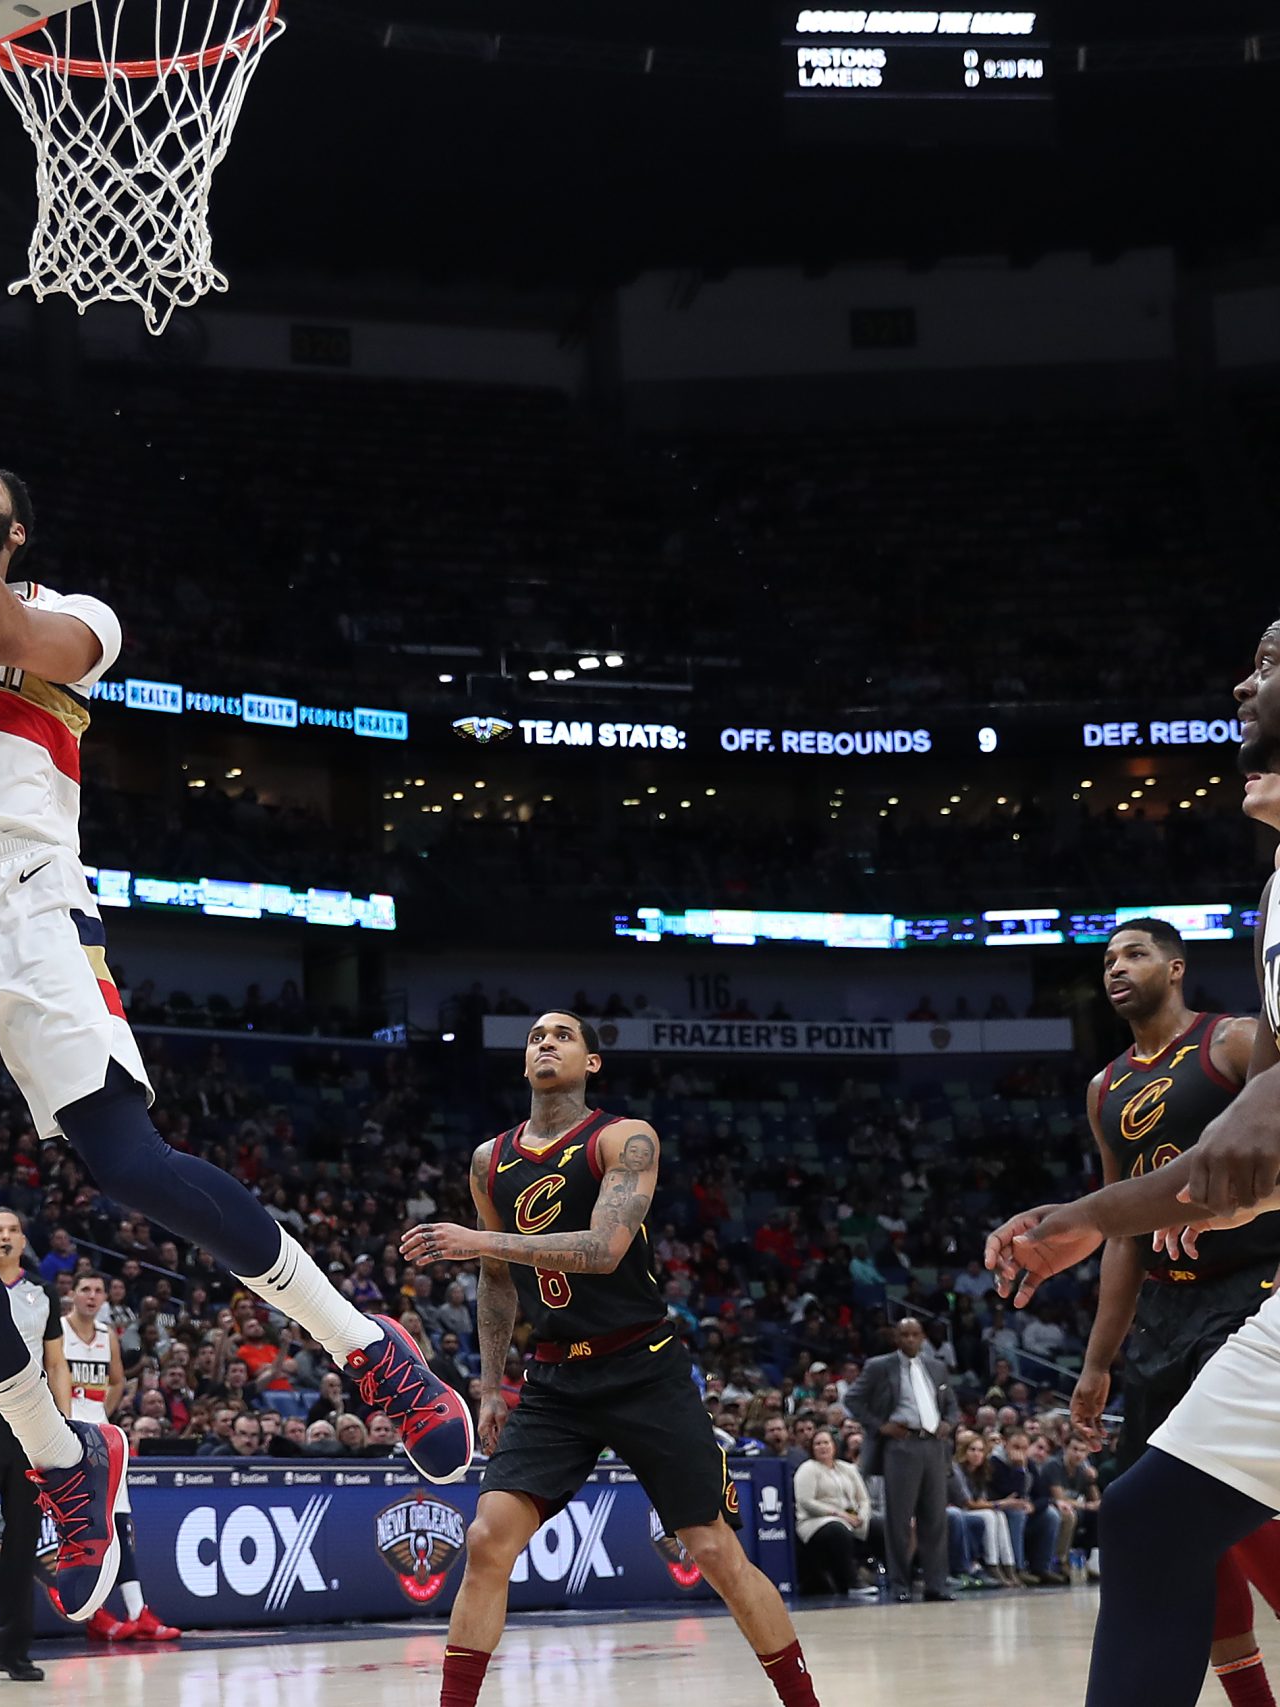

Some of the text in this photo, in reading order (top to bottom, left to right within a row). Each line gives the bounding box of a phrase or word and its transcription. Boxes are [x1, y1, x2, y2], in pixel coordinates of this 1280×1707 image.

[797, 48, 886, 67] PISTONS
[798, 67, 882, 87] LAKERS
[186, 692, 242, 716] PEOPLES
[300, 706, 353, 729] PEOPLES
[518, 719, 592, 746] TEAM
[598, 721, 686, 750] STATS:
[720, 728, 775, 752] OFF.
[782, 729, 932, 755] REBOUNDS
[978, 727, 997, 752] 9
[1083, 721, 1143, 747] DEF.
[685, 973, 731, 1011] 116
[653, 1022, 893, 1049] FRAZIER'S POINT
[1120, 1077, 1173, 1141] C
[514, 1174, 566, 1234] C
[567, 1342, 592, 1358] AVS
[72, 1361, 106, 1385] NOLA
[377, 1504, 464, 1547] NEW ORLEANS
[176, 1494, 332, 1611] COX
